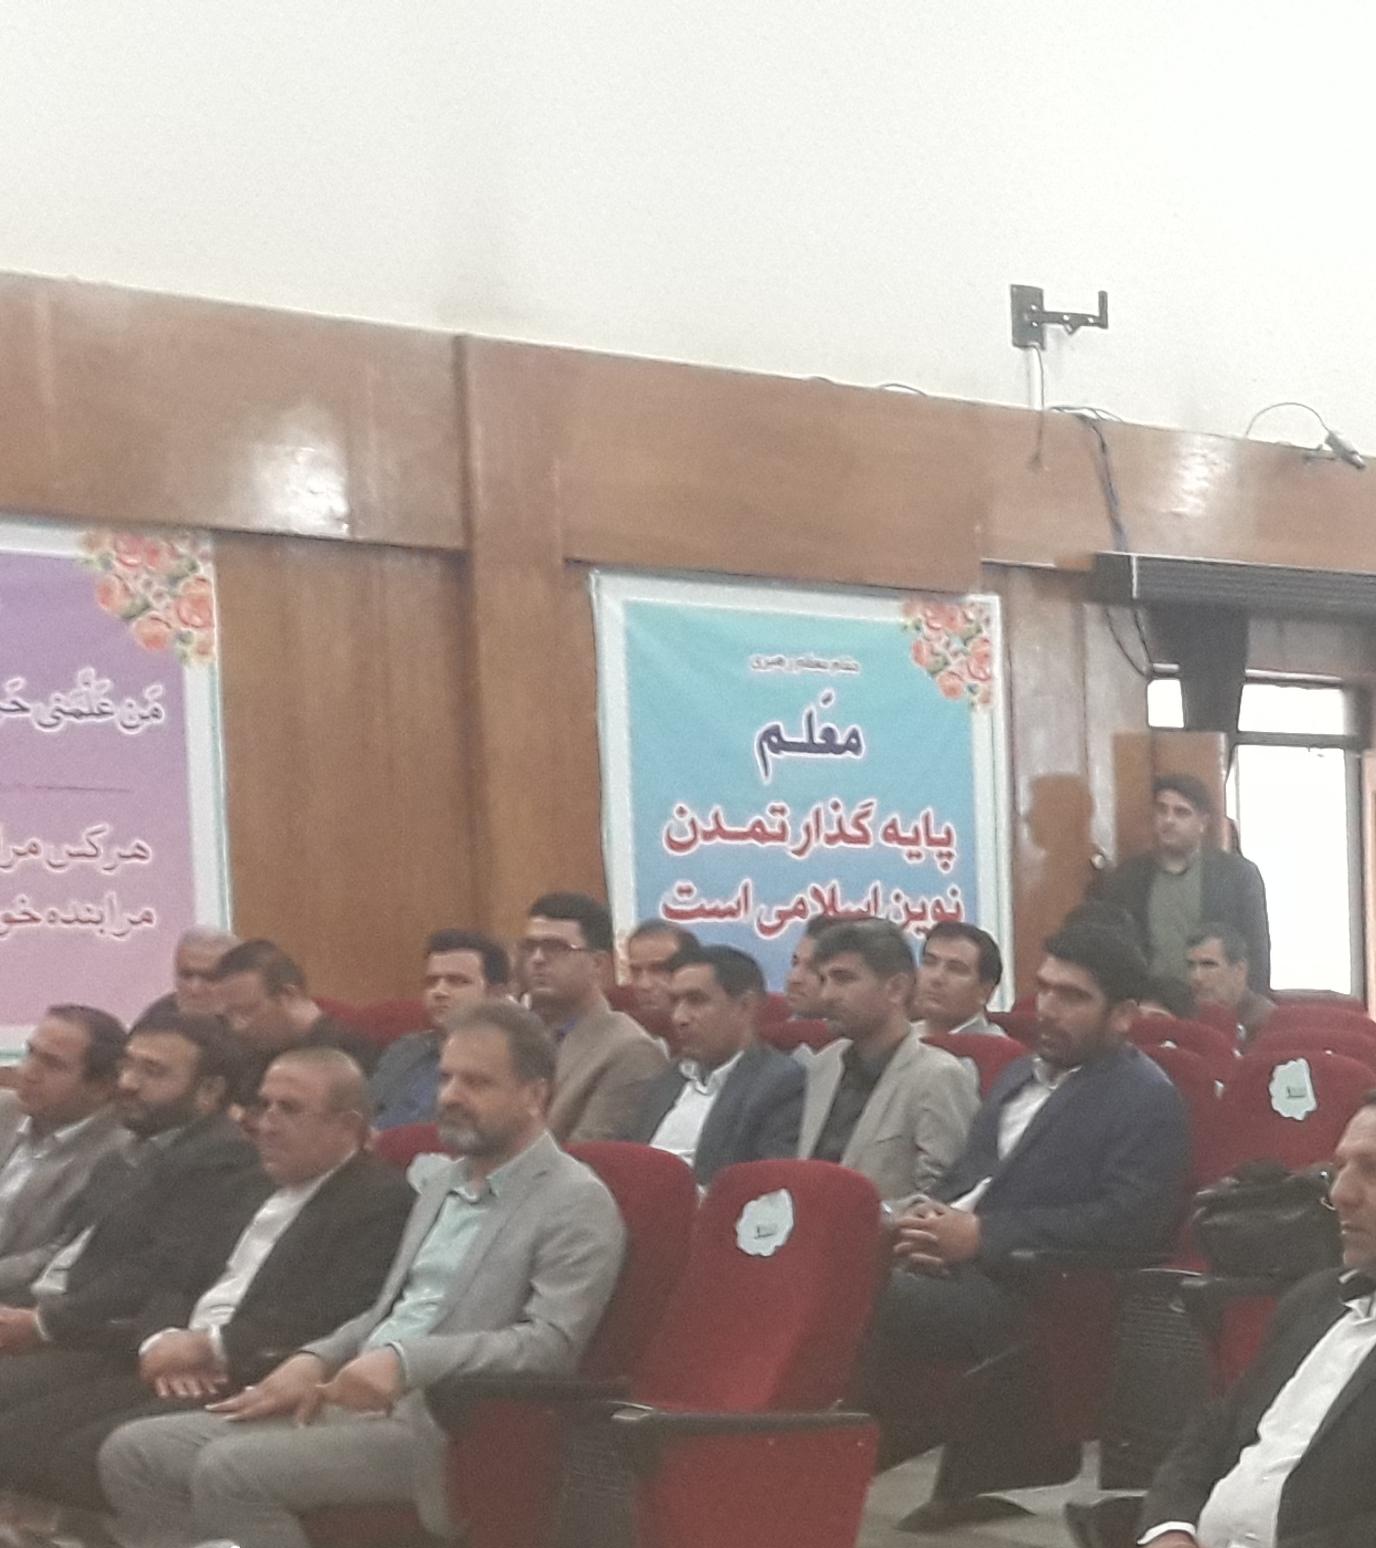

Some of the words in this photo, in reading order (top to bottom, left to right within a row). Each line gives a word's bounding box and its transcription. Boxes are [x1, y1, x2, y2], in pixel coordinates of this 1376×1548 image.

[664, 801, 790, 854] تمدن
[790, 798, 876, 858] گذار
[881, 808, 955, 872] پایه
[0, 895, 43, 938] خو
[48, 903, 105, 934] بنده
[660, 878, 751, 922] است
[755, 880, 880, 938] اسلامی
